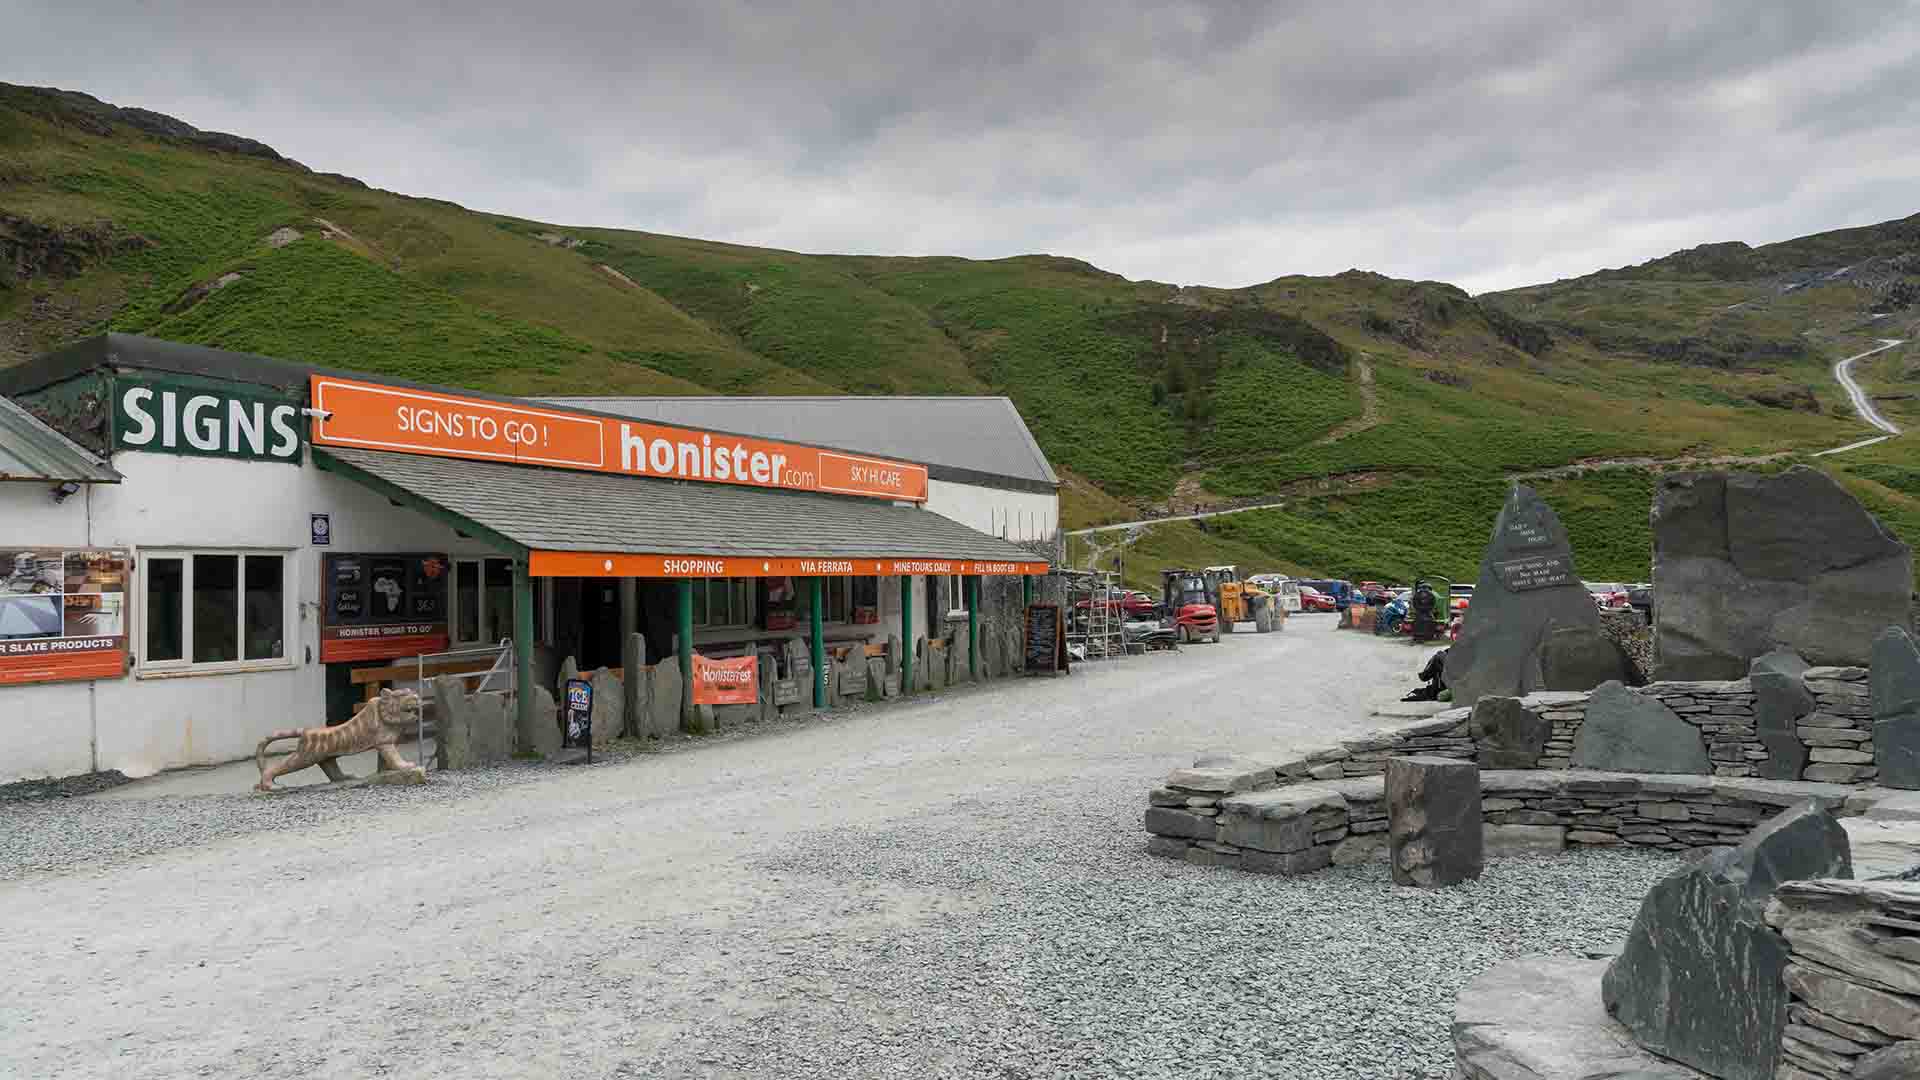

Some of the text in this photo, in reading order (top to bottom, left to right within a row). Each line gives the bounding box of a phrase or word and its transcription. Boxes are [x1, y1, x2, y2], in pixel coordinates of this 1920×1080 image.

[122, 387, 298, 457] SIGNS
[397, 406, 464, 437] SIGNS
[466, 416, 498, 440] TO
[503, 421, 537, 446] GO
[850, 465, 901, 487] SKY HI CAFE
[663, 559, 724, 574] SHOPPING
[799, 561, 853, 573] VIA FERRATA
[893, 561, 951, 573] MINE TOURS DAILY
[339, 627, 380, 637] HONISTER
[8, 641, 49, 653] SLATE
[50, 638, 113, 651] PRODUCTS
[569, 687, 589, 704] ICE
